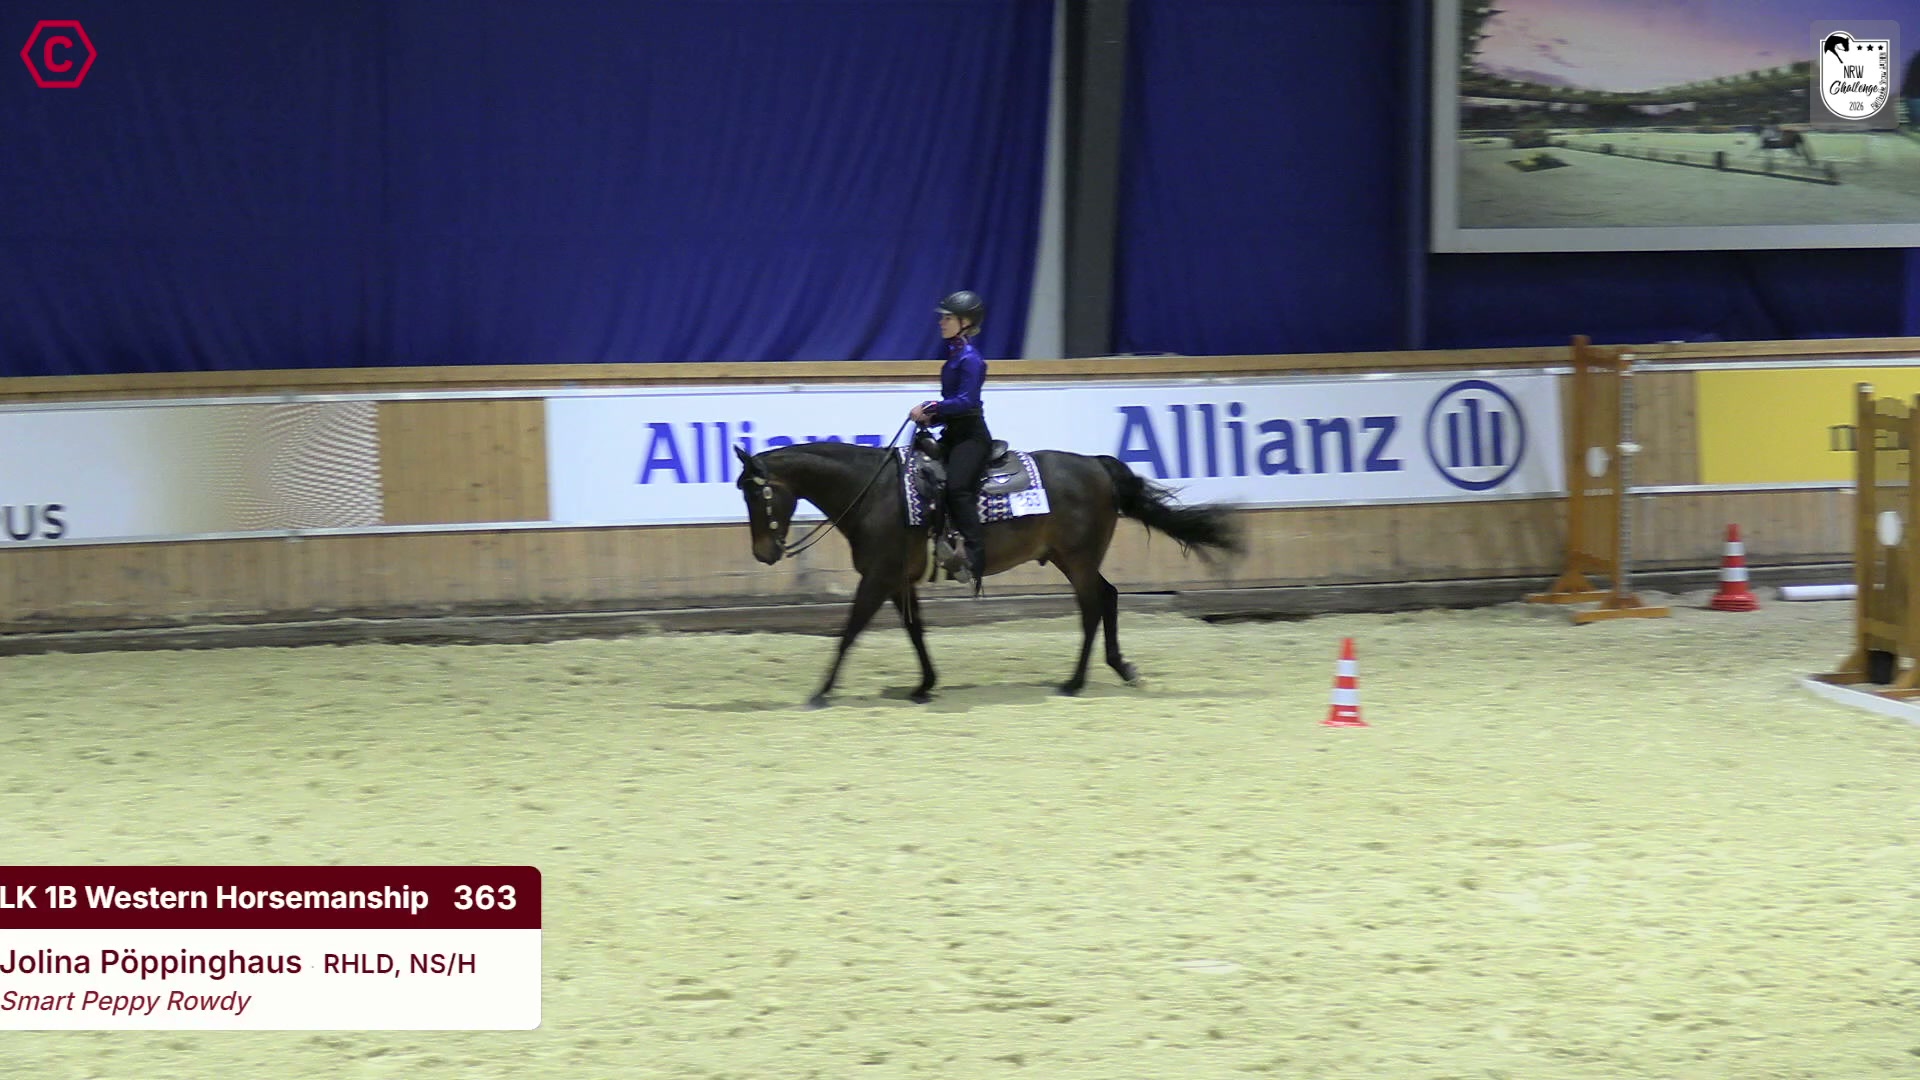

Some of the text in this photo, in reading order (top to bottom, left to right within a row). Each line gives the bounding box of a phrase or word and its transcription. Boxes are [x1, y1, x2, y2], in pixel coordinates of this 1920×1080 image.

[635, 420, 884, 485] Alli
[1116, 400, 1404, 480] Allianz
[0, 503, 66, 541] US
